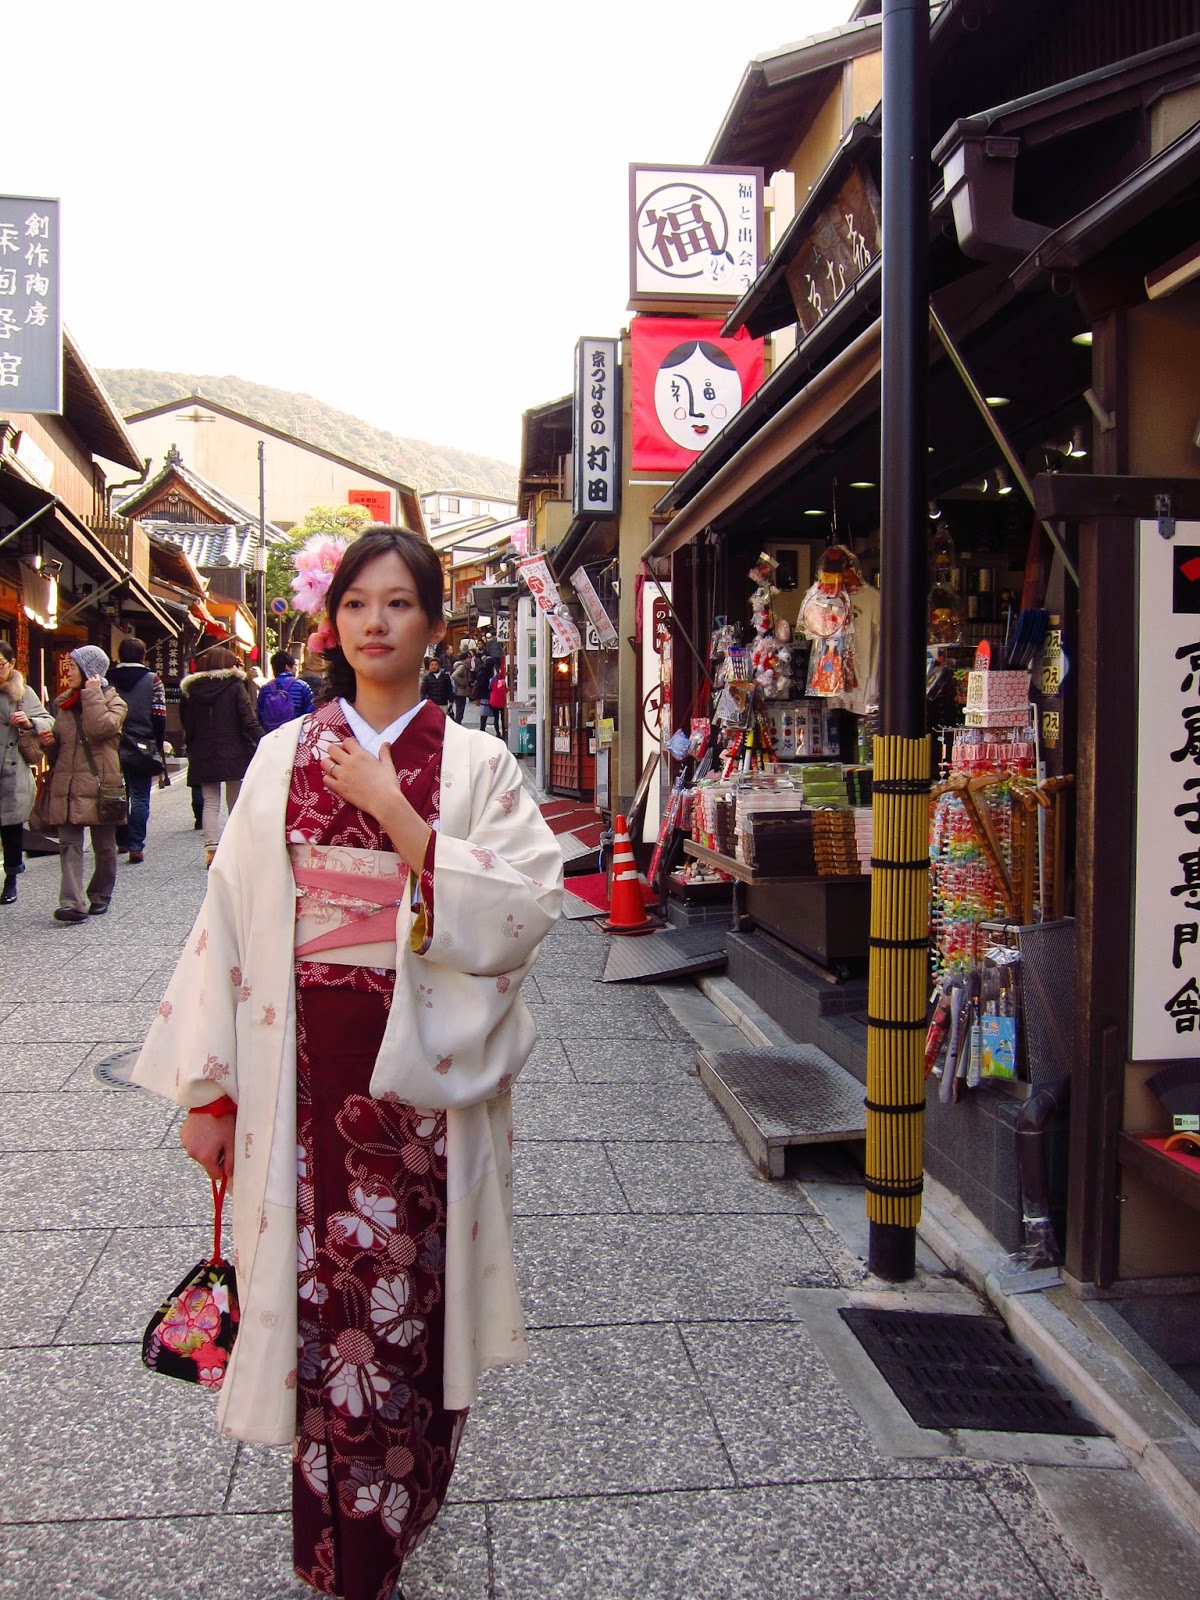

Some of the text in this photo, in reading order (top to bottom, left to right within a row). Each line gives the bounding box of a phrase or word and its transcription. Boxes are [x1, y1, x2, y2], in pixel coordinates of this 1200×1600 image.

[24, 211, 49, 328] 創作陶房
[642, 193, 719, 268] 福
[738, 183, 753, 288] 福と出会う
[587, 350, 610, 503] 京つけもの 打田
[1043, 667, 1059, 684] つえ
[1043, 713, 1059, 730] つえ
